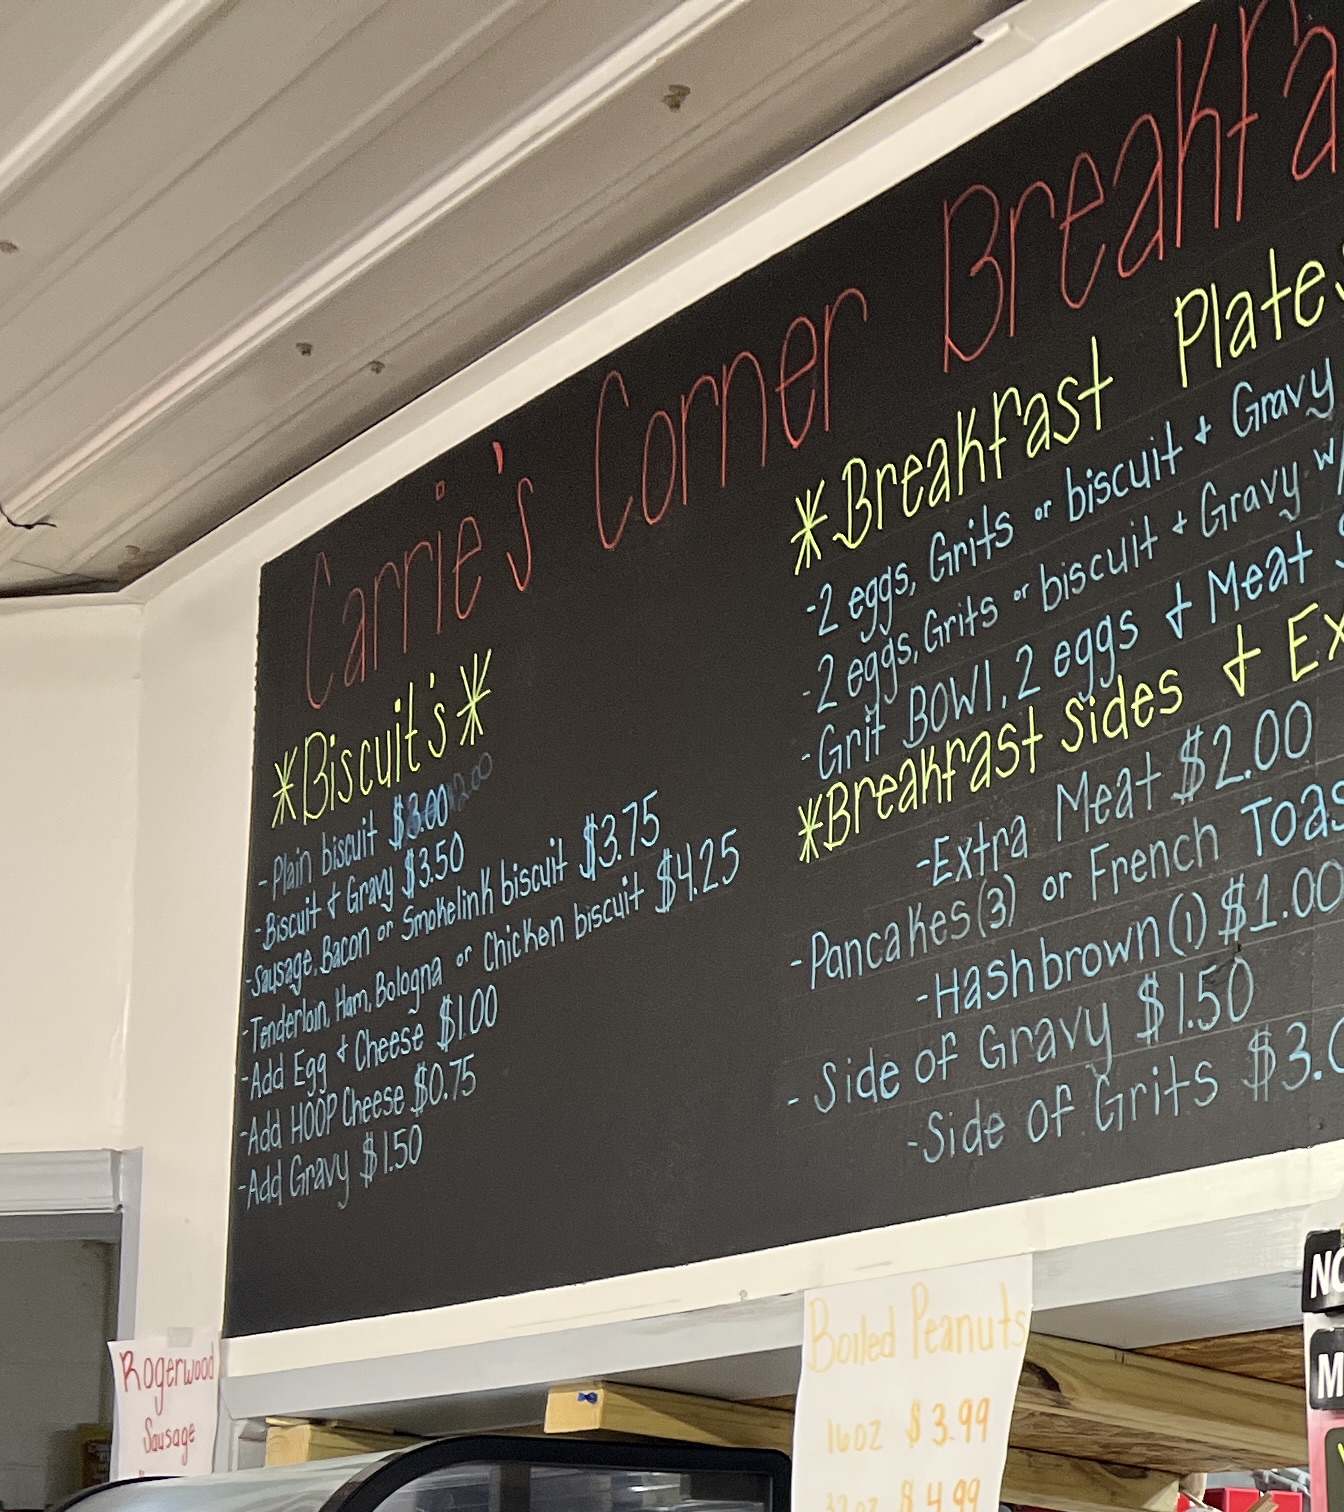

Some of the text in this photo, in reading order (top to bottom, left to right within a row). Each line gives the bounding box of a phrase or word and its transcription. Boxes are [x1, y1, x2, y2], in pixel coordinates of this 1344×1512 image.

[304, 440, 535, 711] Carrie's
[594, 289, 869, 551] Corner
[833, 336, 1113, 549] Breakfast
[930, 505, 1014, 582] Grits
[1035, 501, 1052, 521] or
[1067, 421, 1182, 522] biscuit
[1231, 357, 1335, 437] Gravy
[924, 595, 998, 653] Grits
[1014, 582, 1029, 602] or
[1041, 515, 1158, 612] biscuit
[1201, 460, 1301, 538] Gravy
[1017, 644, 1040, 700] 2
[1053, 610, 1139, 701] eggs
[1207, 530, 1313, 624] Meat
[823, 706, 1043, 851] Breakfast
[1056, 700, 1313, 842] Meat $2.00
[320, 926, 370, 974] Bacon
[377, 921, 393, 941] or
[501, 838, 568, 906] biscuit
[580, 790, 659, 881] $3.75
[322, 810, 377, 876] biscuit
[347, 831, 464, 913] Gravy $3.50
[1042, 869, 1072, 901] or
[1090, 816, 1218, 901] French
[376, 956, 443, 1014] Bologna
[456, 945, 472, 967] or
[484, 915, 564, 971] Chicken
[574, 871, 644, 940] biscuit
[655, 829, 740, 913] $4.25
[294, 984, 499, 1097] Egg Cheese $1.00
[914, 1030, 959, 1081] of
[978, 1002, 1114, 1080] Gravy
[1137, 957, 1254, 1046] $1.50
[342, 1085, 405, 1127] Cheese
[410, 1053, 476, 1117] $0.75
[1027, 1083, 1075, 1143] of
[1094, 1055, 1218, 1133] Grits
[289, 1124, 422, 1210] Gravy $1.50
[119, 1341, 214, 1416] Rogerwood
[807, 1281, 1027, 1373] Boiled Peanuts
[143, 1417, 196, 1466] Sausage
